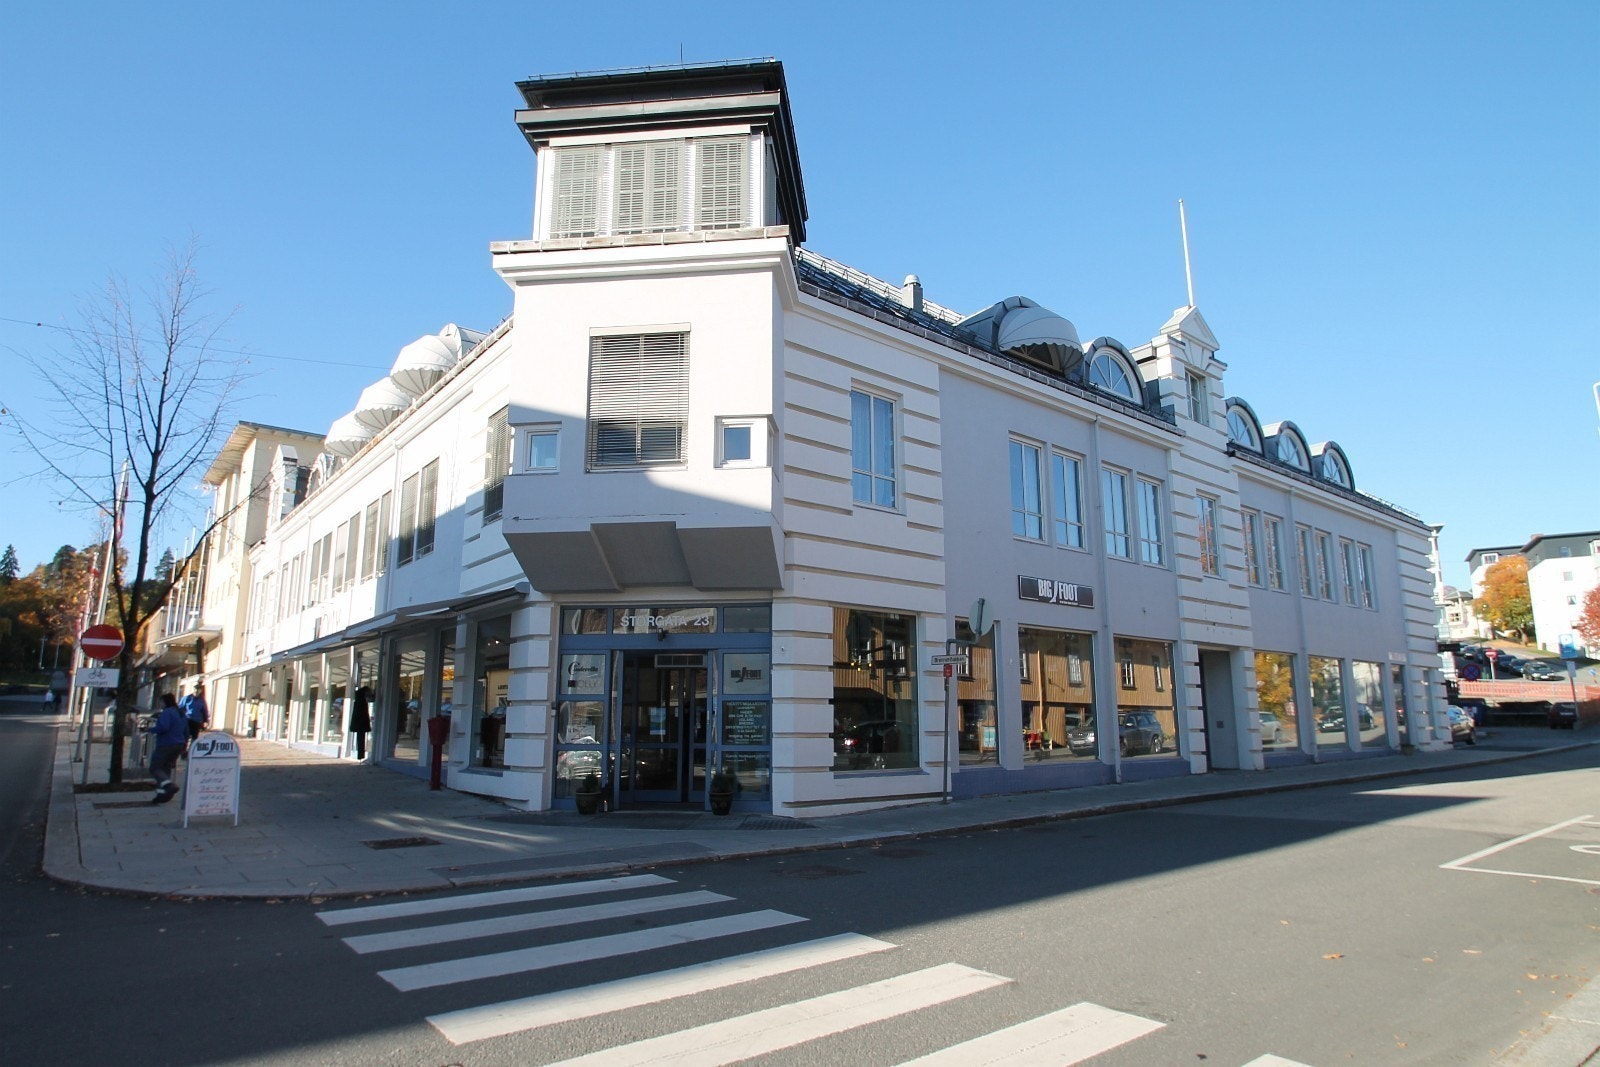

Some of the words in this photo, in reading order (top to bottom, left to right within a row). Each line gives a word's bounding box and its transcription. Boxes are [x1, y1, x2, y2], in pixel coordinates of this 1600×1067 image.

[1038, 579, 1053, 598] BIG
[1059, 583, 1078, 602] FOOT
[621, 616, 687, 627] STORGATA
[694, 616, 710, 626] 23
[196, 743, 210, 751] BIG
[215, 742, 234, 752] FOOT
